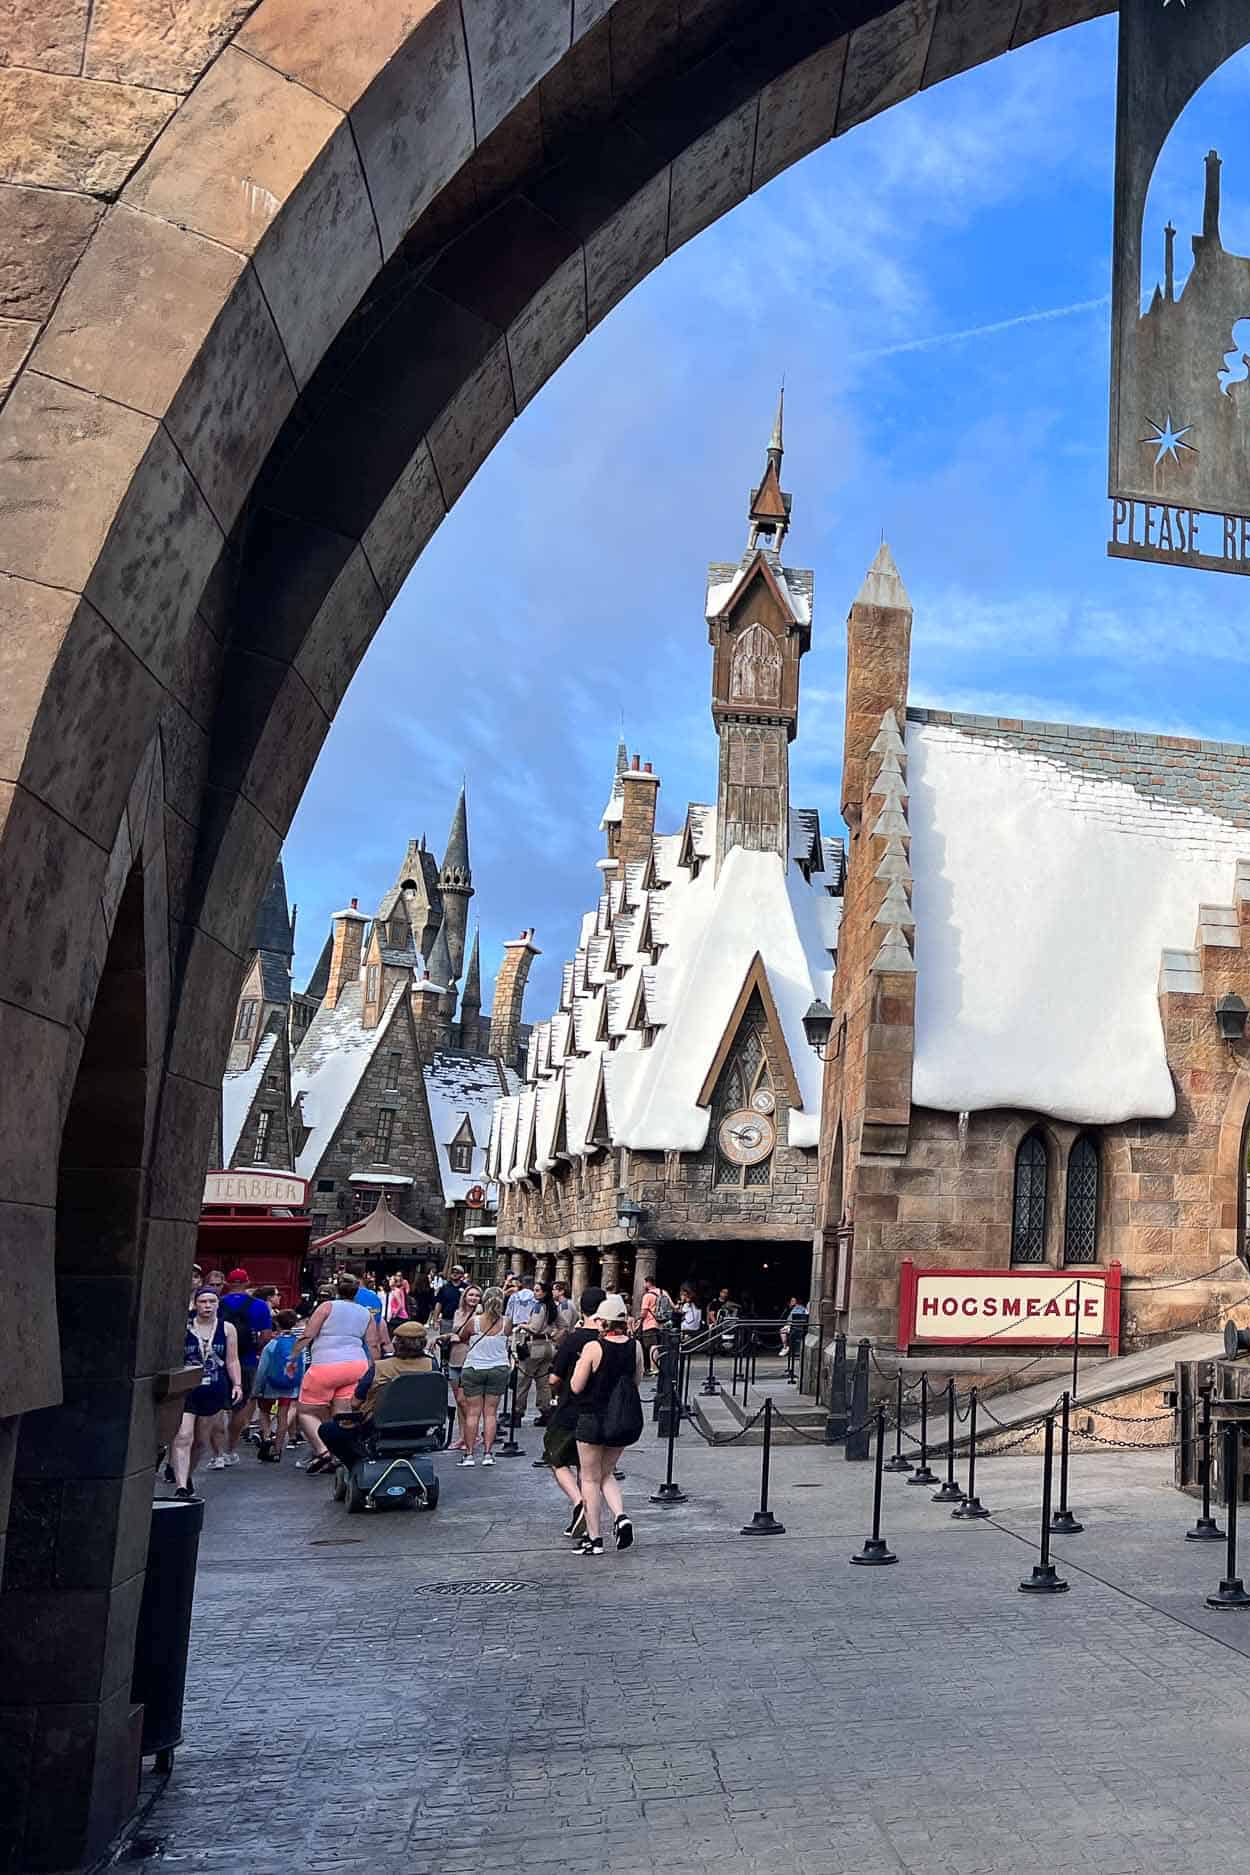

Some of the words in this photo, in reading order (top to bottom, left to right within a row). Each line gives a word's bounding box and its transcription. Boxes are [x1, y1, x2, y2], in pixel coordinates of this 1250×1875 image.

[1112, 498, 1200, 553] PLEASE
[215, 1177, 297, 1201] TERBEER
[922, 1297, 1099, 1317] HOGSMEADE
